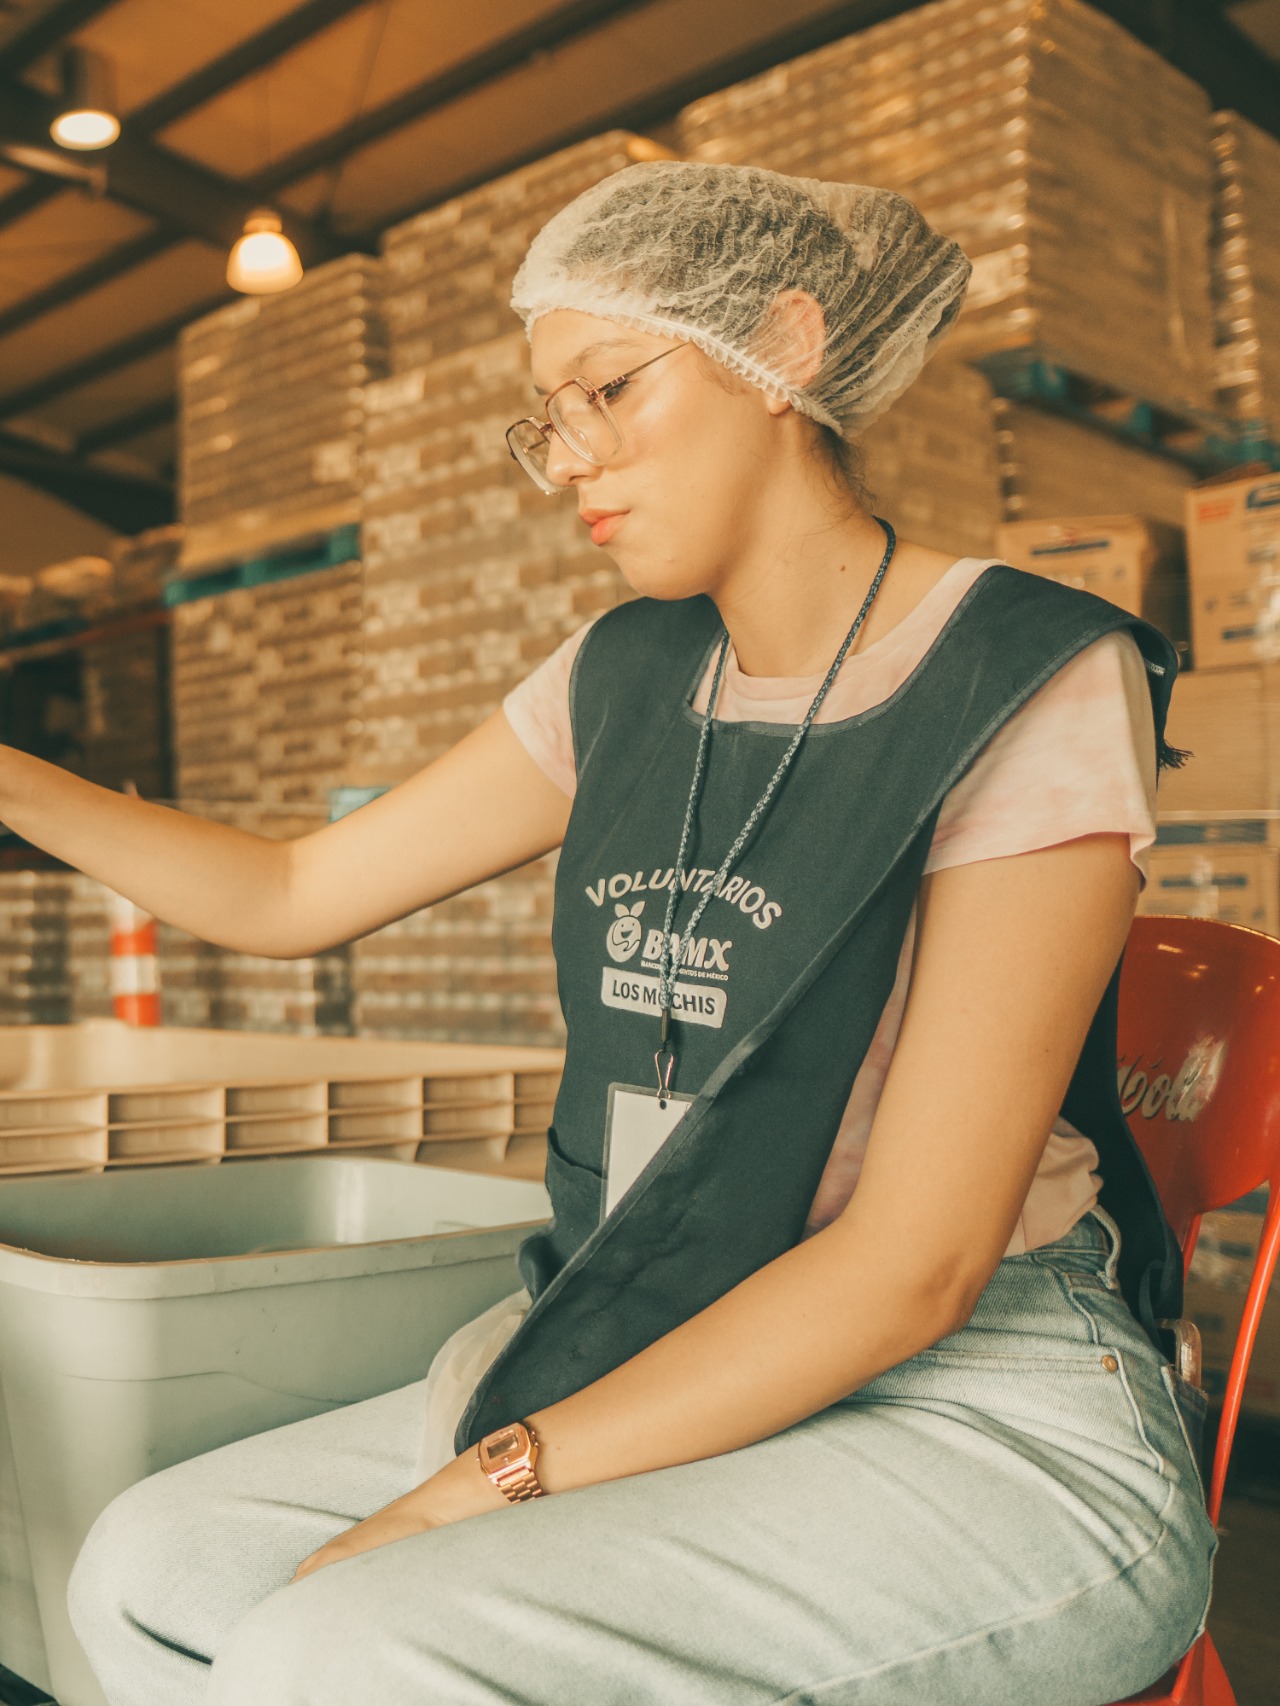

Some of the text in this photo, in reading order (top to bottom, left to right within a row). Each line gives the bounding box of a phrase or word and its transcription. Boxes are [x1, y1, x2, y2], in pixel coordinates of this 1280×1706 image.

[585, 868, 782, 929] VOLUNTARIOS
[642, 928, 732, 971] BAMX
[612, 980, 715, 1015] LOS MCHIS
